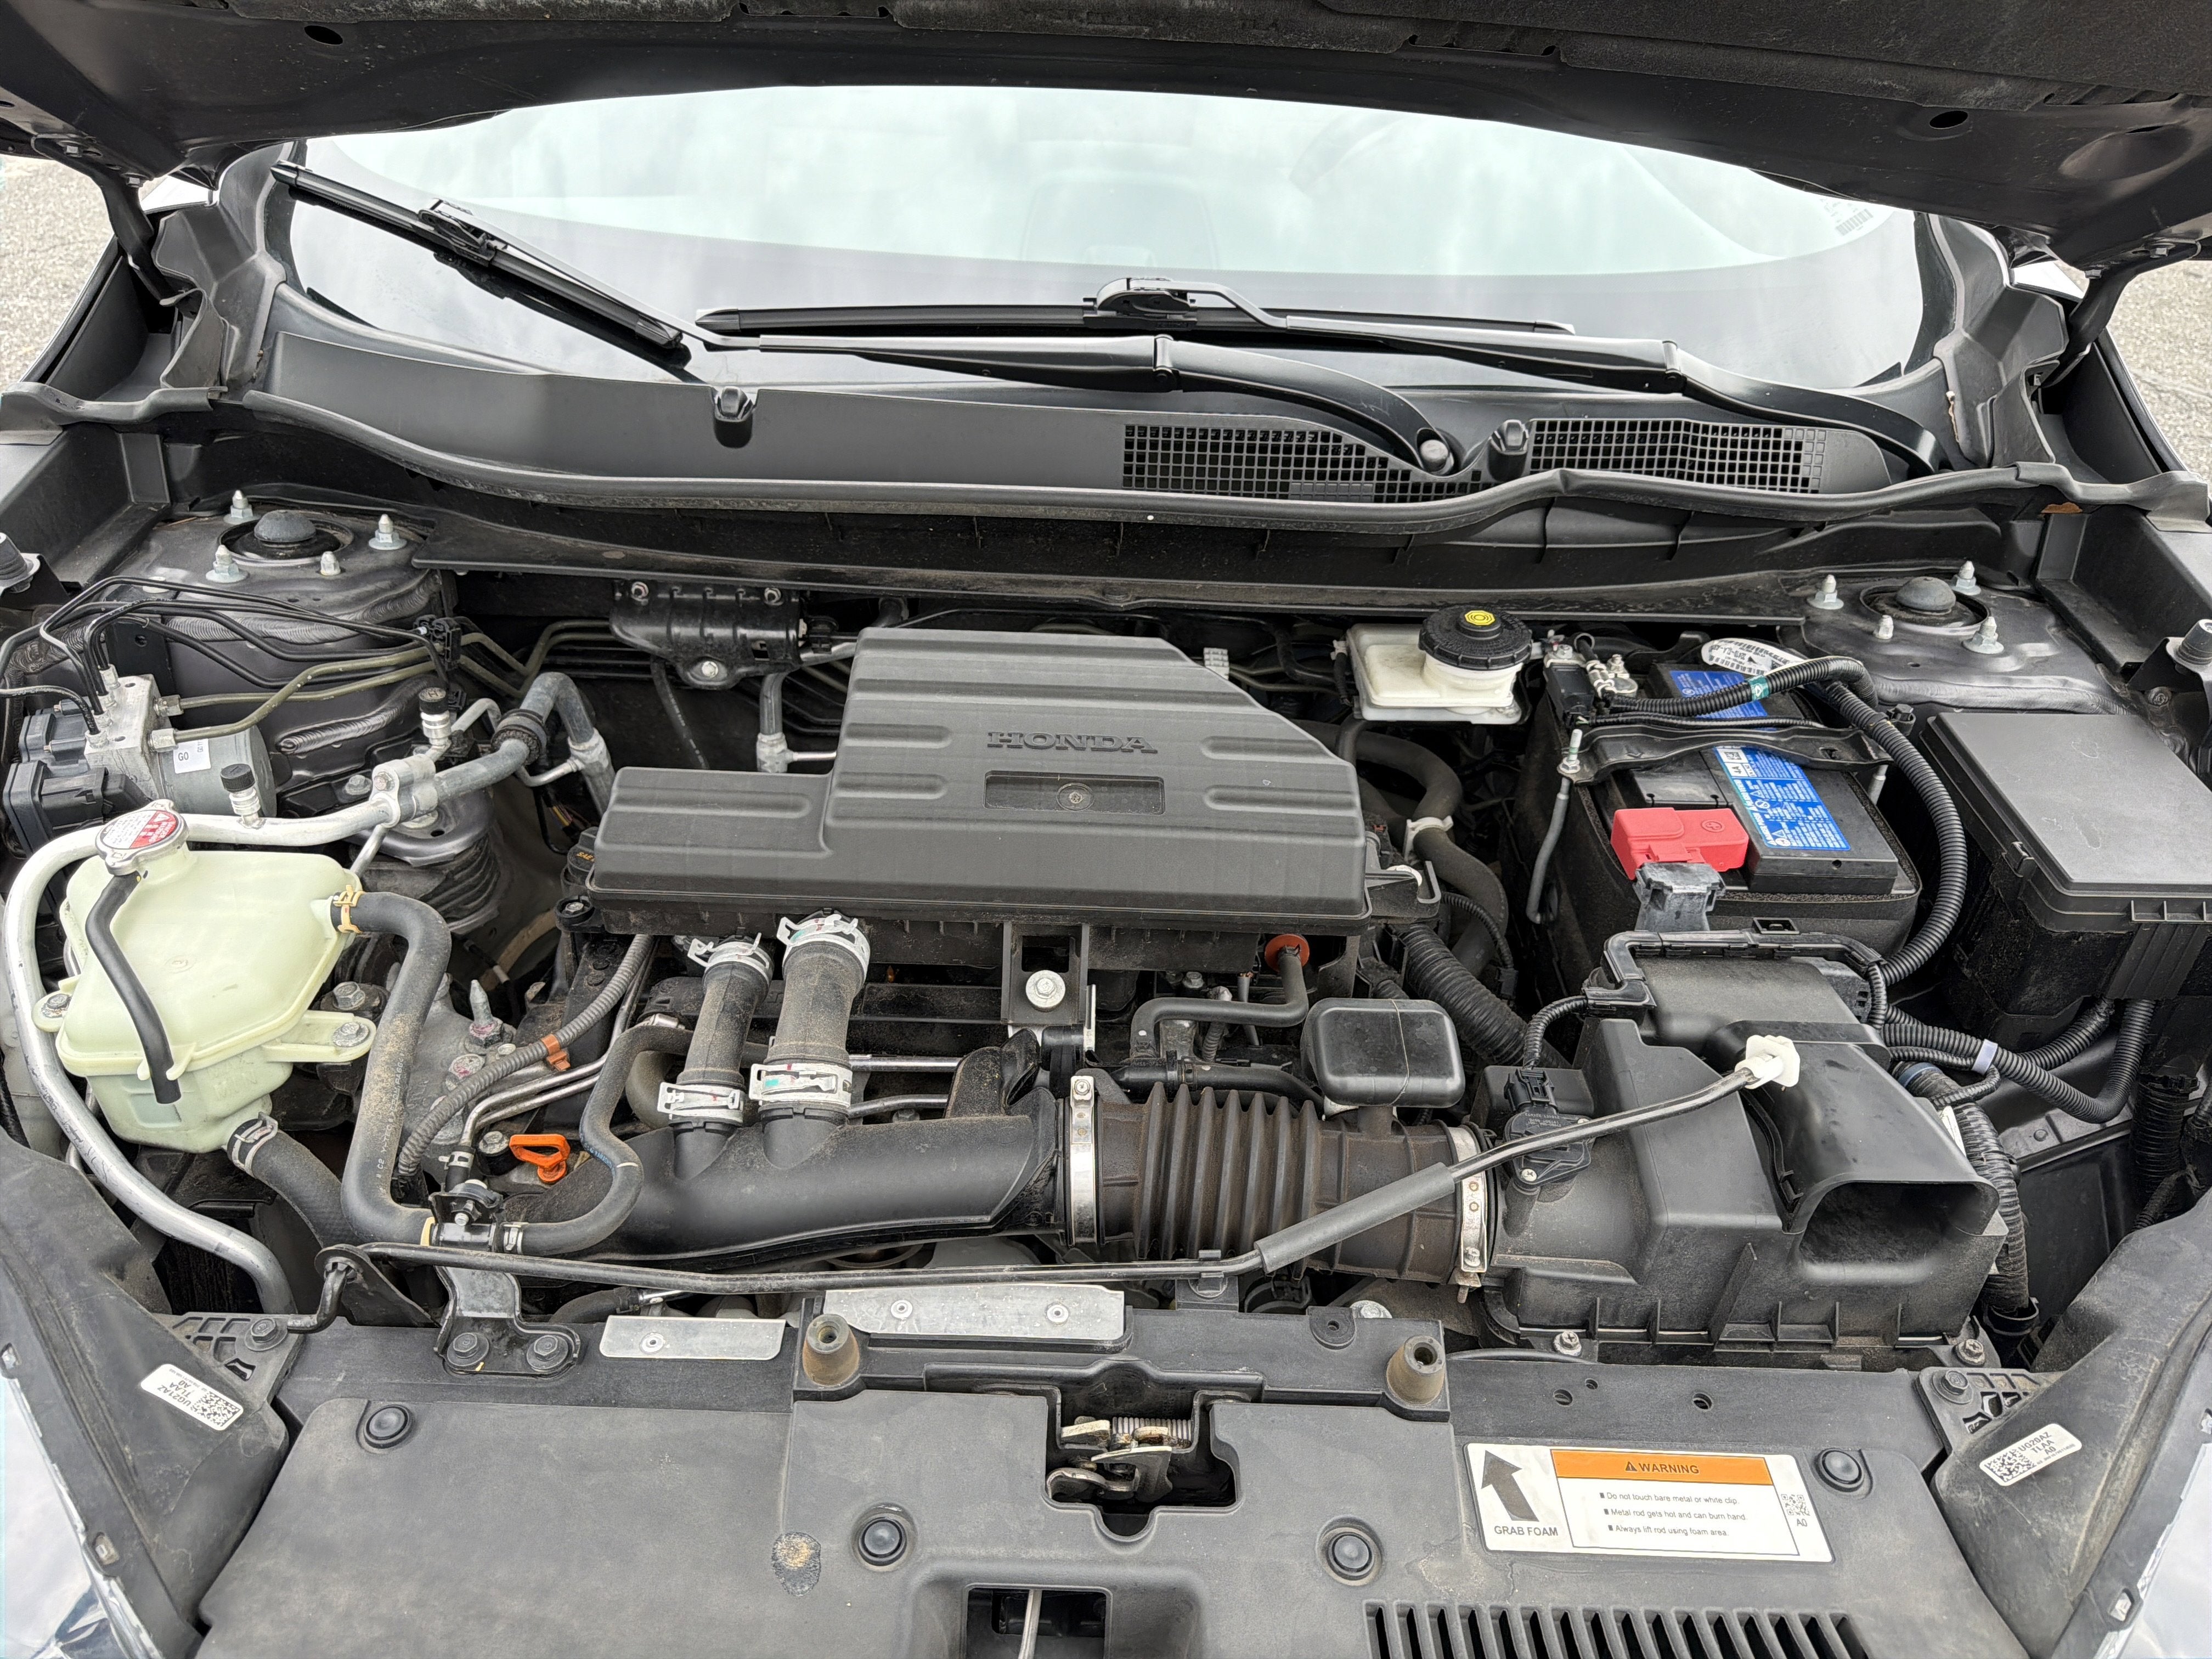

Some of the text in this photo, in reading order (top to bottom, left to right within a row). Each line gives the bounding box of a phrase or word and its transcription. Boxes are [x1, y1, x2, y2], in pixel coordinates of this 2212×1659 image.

[987, 731, 1158, 753] HONDA
[157, 1385, 191, 1407] UG21AZ
[170, 1383, 191, 1398] TLAA
[2018, 1432, 2052, 1452] UG20AZ
[2030, 1440, 2055, 1453] TLAA
[1639, 1463, 1699, 1474] WARNING
[1494, 1526, 1558, 1536] GRAB FOAM
[1616, 1525, 1641, 1534] Always
[1668, 1528, 1688, 1536] using
